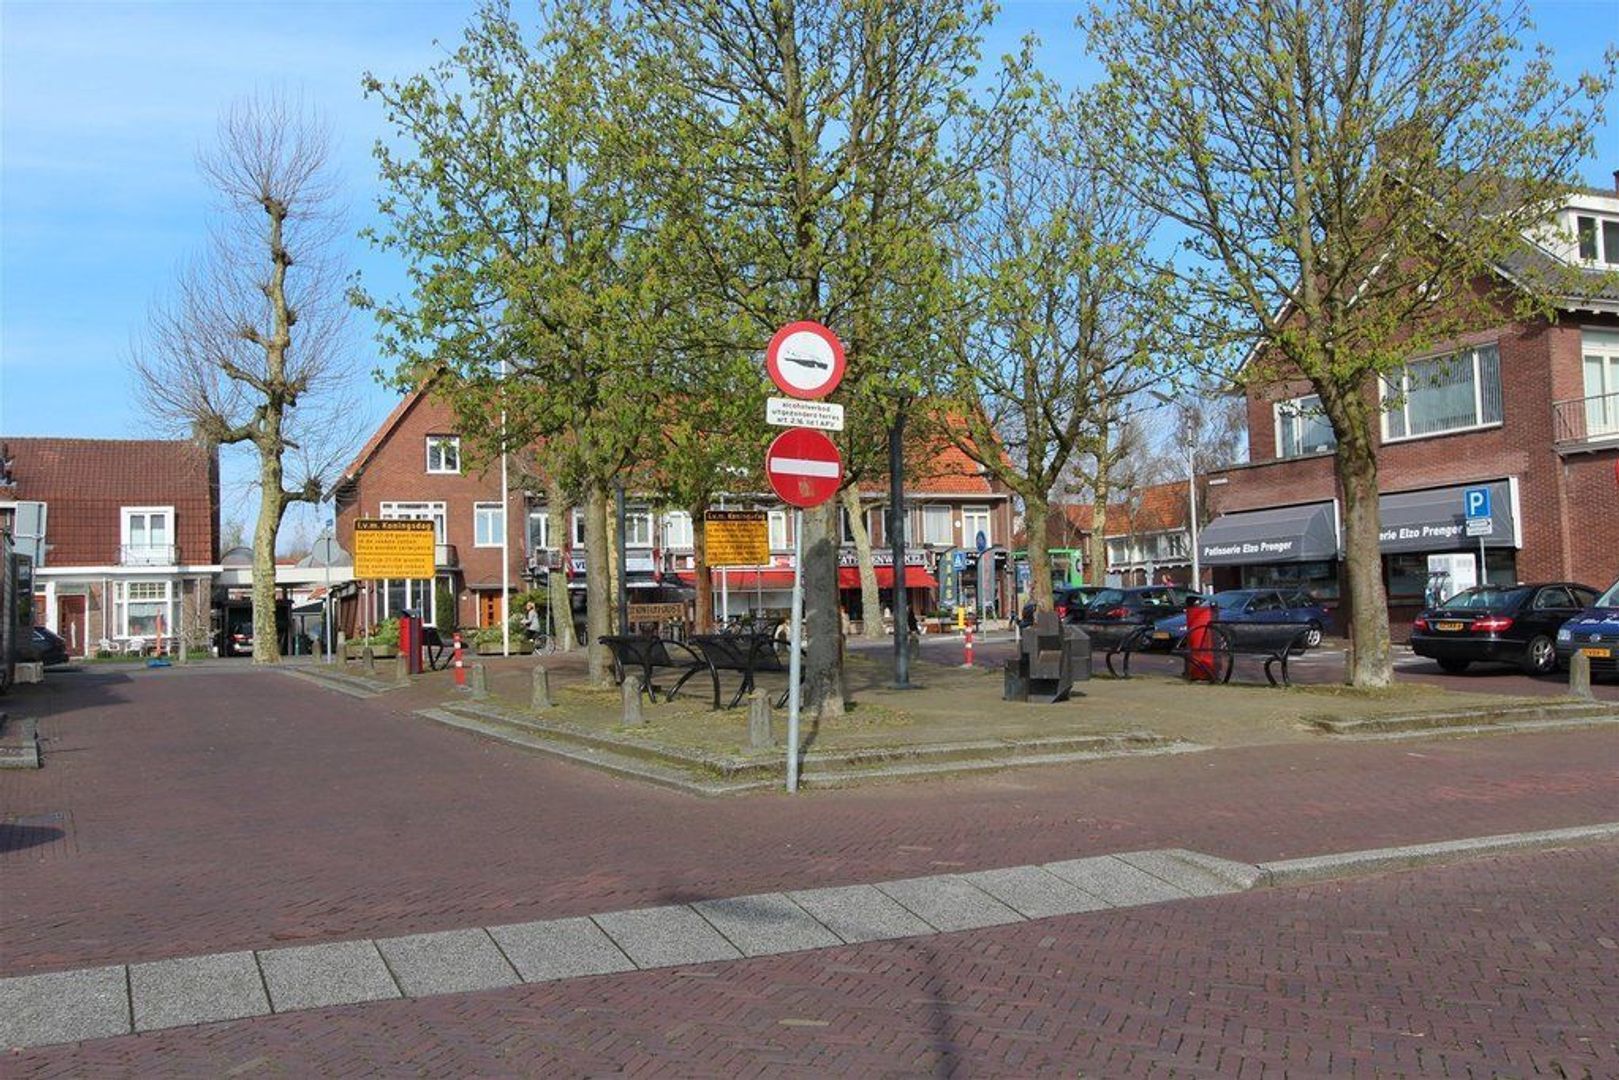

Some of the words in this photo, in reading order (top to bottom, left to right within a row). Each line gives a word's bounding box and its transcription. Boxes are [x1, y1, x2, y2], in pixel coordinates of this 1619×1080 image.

[1470, 492, 1483, 515] P
[382, 522, 431, 531] Koningsdag
[1379, 530, 1398, 541] erie
[1399, 527, 1420, 540] Elzo
[1422, 525, 1463, 537] Prenger
[1204, 545, 1241, 556] Patisserie
[1242, 543, 1260, 554] Elzo
[1261, 541, 1292, 552] Prenger
